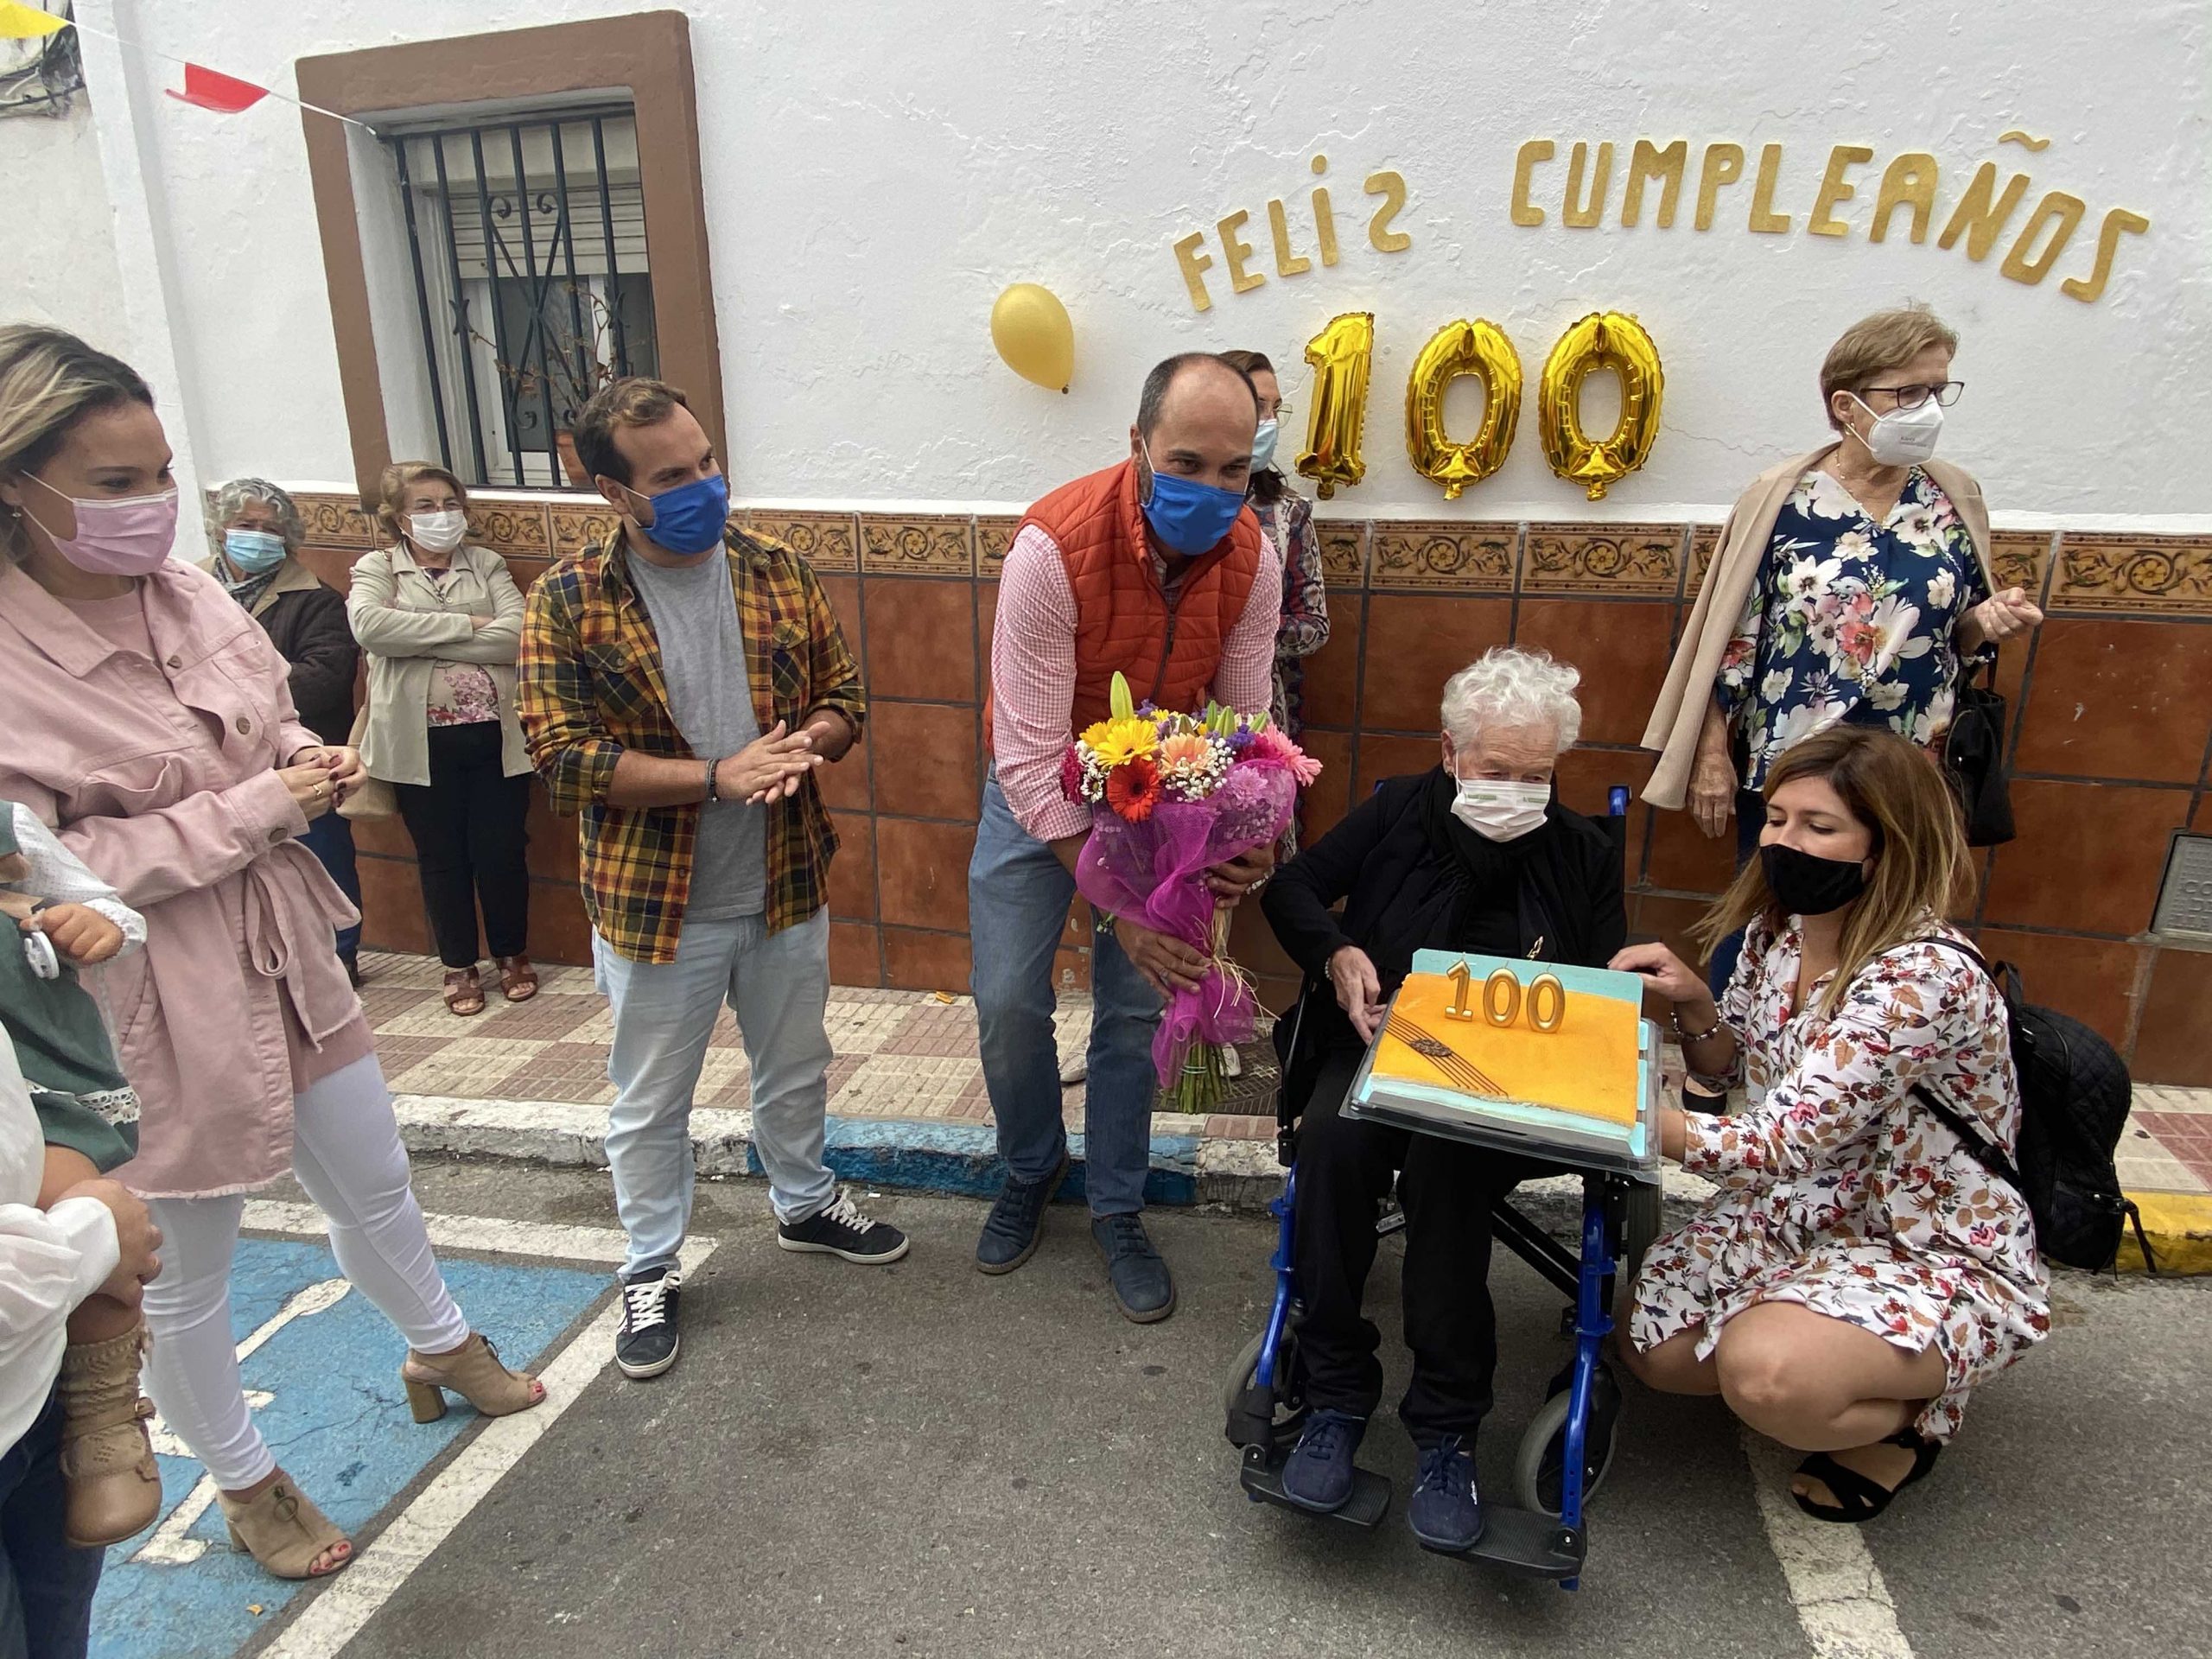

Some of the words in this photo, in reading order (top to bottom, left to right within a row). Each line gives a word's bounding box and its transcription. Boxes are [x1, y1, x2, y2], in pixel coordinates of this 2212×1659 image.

[1510, 130, 2150, 303] CUMPLEAÑOS
[1294, 311, 1665, 501] 100
[1444, 959, 1566, 1034] 100
